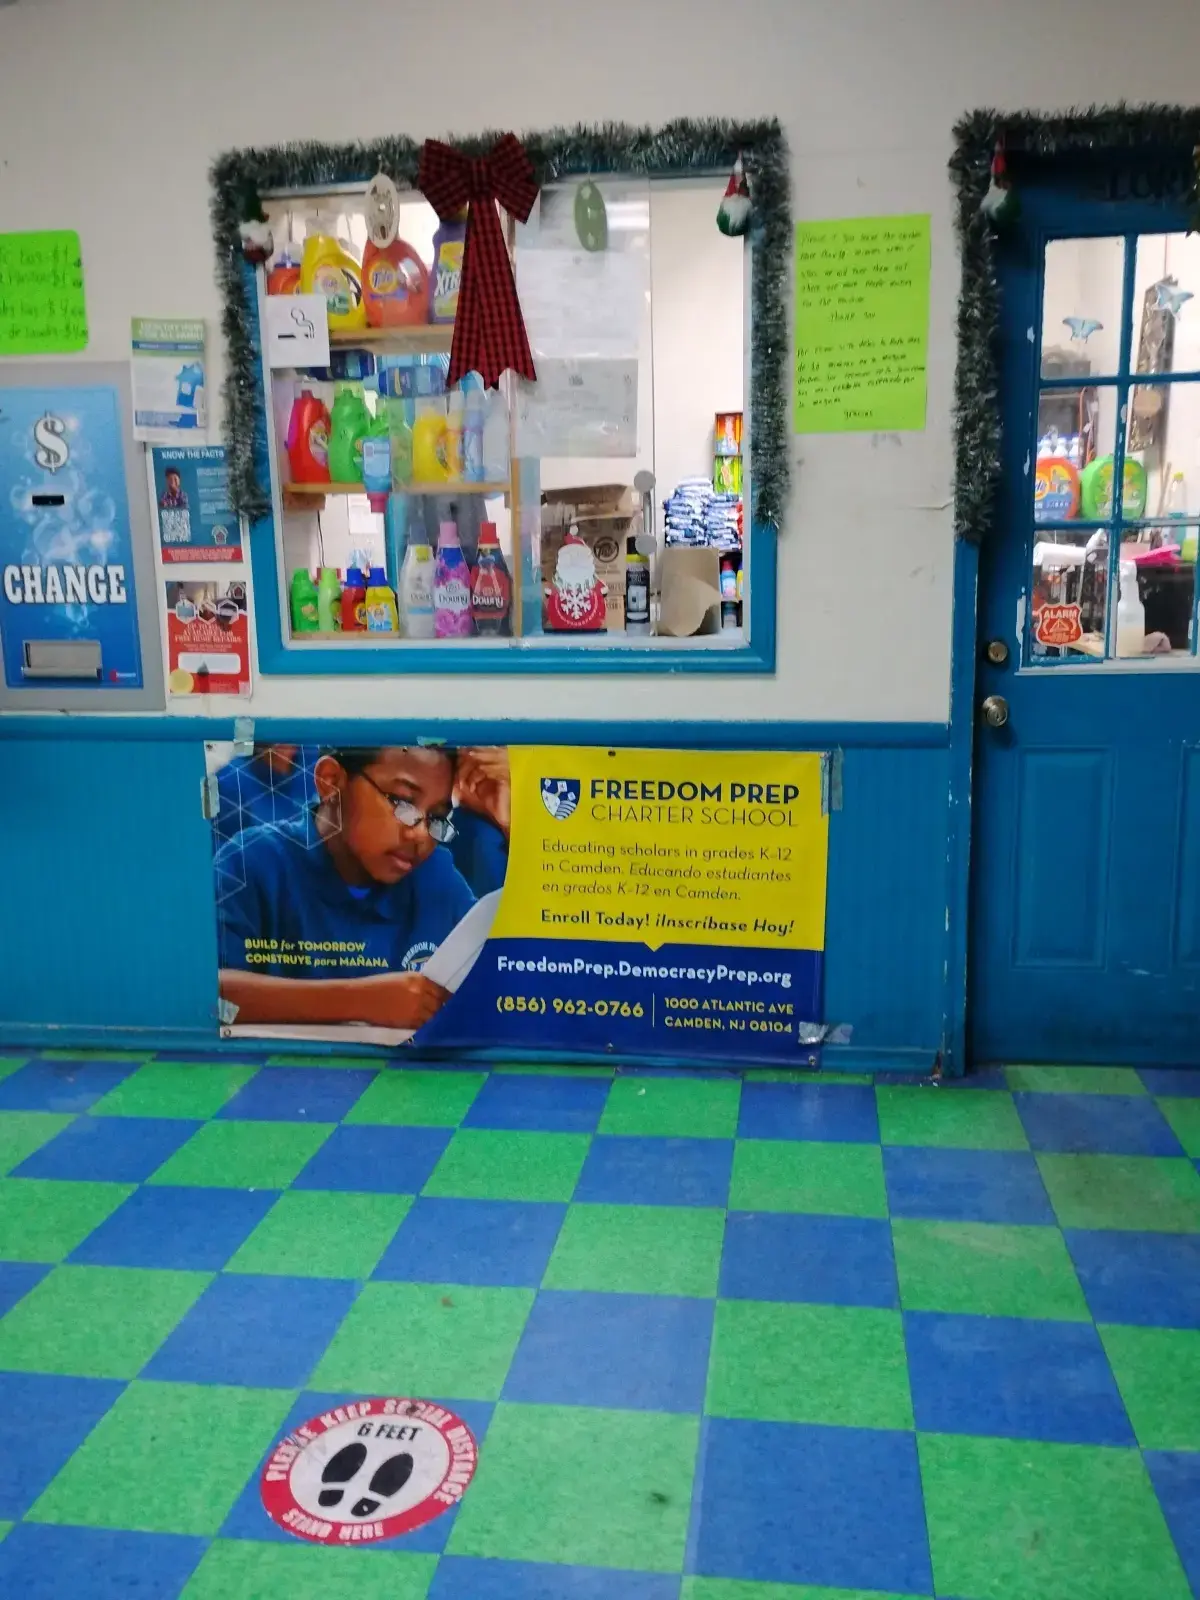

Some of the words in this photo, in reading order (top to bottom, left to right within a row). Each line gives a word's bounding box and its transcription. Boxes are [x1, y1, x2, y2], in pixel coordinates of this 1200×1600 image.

[435, 270, 460, 297] XTR
[161, 450, 185, 459] KNOW
[187, 450, 200, 459] THE
[201, 450, 225, 459] FACTS
[4, 564, 127, 604] CHANGE
[440, 594, 468, 606] Downy
[473, 594, 504, 609] Downy
[1043, 609, 1077, 618] ALARM
[590, 779, 722, 803] FREEDOM
[730, 783, 800, 805] PREP
[591, 804, 694, 824] CHARTER
[700, 806, 799, 828] SCHOOL
[542, 838, 615, 858] Educating
[620, 842, 680, 857] scholars
[685, 846, 698, 858] in
[702, 845, 754, 862] grades
[760, 847, 792, 861] K-12
[542, 860, 554, 872] in
[559, 859, 624, 875] Camden.
[629, 861, 701, 879] Educando
[706, 866, 791, 881] estudiantes
[542, 882, 559, 893] en
[563, 880, 612, 896] grados
[617, 881, 650, 895] K-12
[654, 886, 671, 897] en
[676, 884, 741, 900] Camden.
[541, 908, 590, 924] Enroll
[595, 911, 650, 931] Today!
[753, 917, 795, 937] Hoy!
[244, 938, 278, 949] BUILD
[281, 939, 295, 951] for
[298, 940, 366, 952] TOMORROW
[245, 953, 312, 965] CONSTRUYE
[314, 957, 336, 968] para
[339, 955, 389, 968] MAÑANA
[497, 955, 792, 988] FreedomPrep.DemocracyPrep.org
[496, 995, 546, 1015] (856)
[552, 998, 644, 1018] 962-0766
[664, 997, 699, 1010] 1000
[702, 999, 765, 1013] ATLANTIC
[768, 1003, 794, 1015] AVE
[664, 1016, 725, 1031] CAMDEN,
[729, 1019, 746, 1031] NJ
[749, 1020, 792, 1034] 08104
[320, 1402, 371, 1429] KEEP
[384, 1399, 453, 1429] SOCIAL
[356, 1422, 371, 1438] 6
[376, 1423, 424, 1442] FEET
[282, 1508, 333, 1539] STAND
[339, 1521, 384, 1541] HERE
